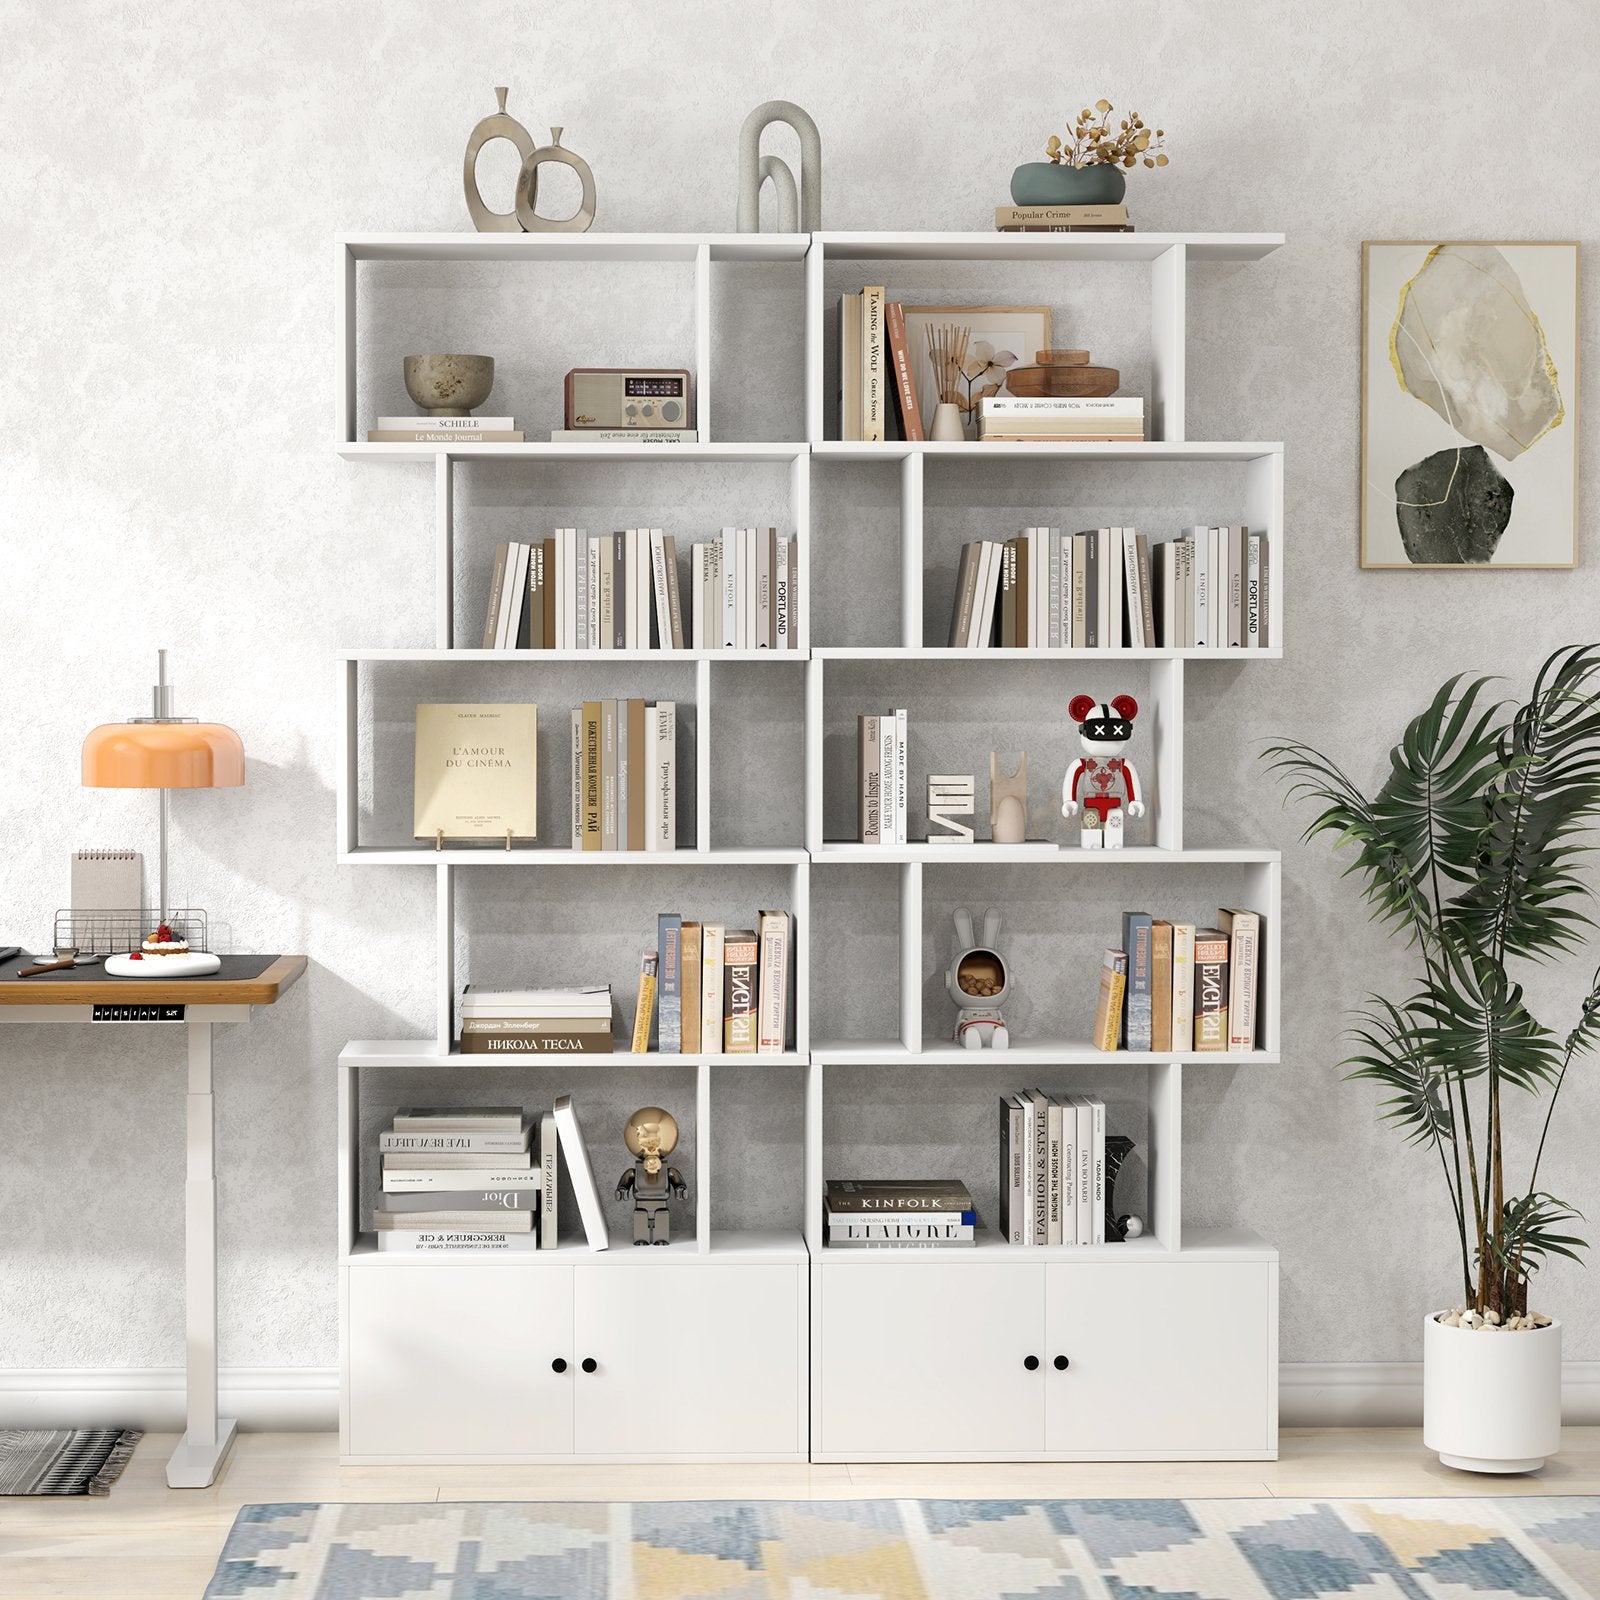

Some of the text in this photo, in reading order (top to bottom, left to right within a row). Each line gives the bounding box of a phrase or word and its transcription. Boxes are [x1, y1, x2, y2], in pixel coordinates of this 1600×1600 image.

[1012, 211, 1071, 220] Popular Crime
[871, 292, 880, 330] TAMING
[871, 345, 880, 373] WOLF
[898, 350, 914, 410] WHY DO WE LOVE CATS
[439, 419, 479, 428] SCHIELE
[455, 434, 482, 442] Journal
[778, 582, 786, 635] PORTLAND
[1250, 581, 1258, 633] PORTLAND
[453, 747, 505, 756] L'AMOUR
[884, 734, 892, 758] FRIENDS
[446, 758, 511, 768] DU CINÉMA
[575, 751, 583, 780] Уличный
[588, 721, 597, 807] БОЖЕСТВЕННАЯ КОМЕДИЯ
[884, 759, 892, 779] AMONG
[899, 770, 904, 780] BY
[884, 780, 892, 797] HOME
[575, 794, 580, 802] по
[661, 761, 670, 839] Триумфальная арка
[864, 772, 880, 836] Rooms to Inspire
[884, 797, 892, 813] YOUR
[588, 812, 599, 833] РАЙ
[575, 825, 583, 838] Боб
[469, 1020, 540, 1031] Джордан Элленберг
[487, 1039, 583, 1050] НИКОЛА ТЕСЛА
[1036, 1111, 1045, 1235] FASHION & STYLE
[1082, 1168, 1088, 1179] BO
[861, 1199, 942, 1208] KINFOLK
